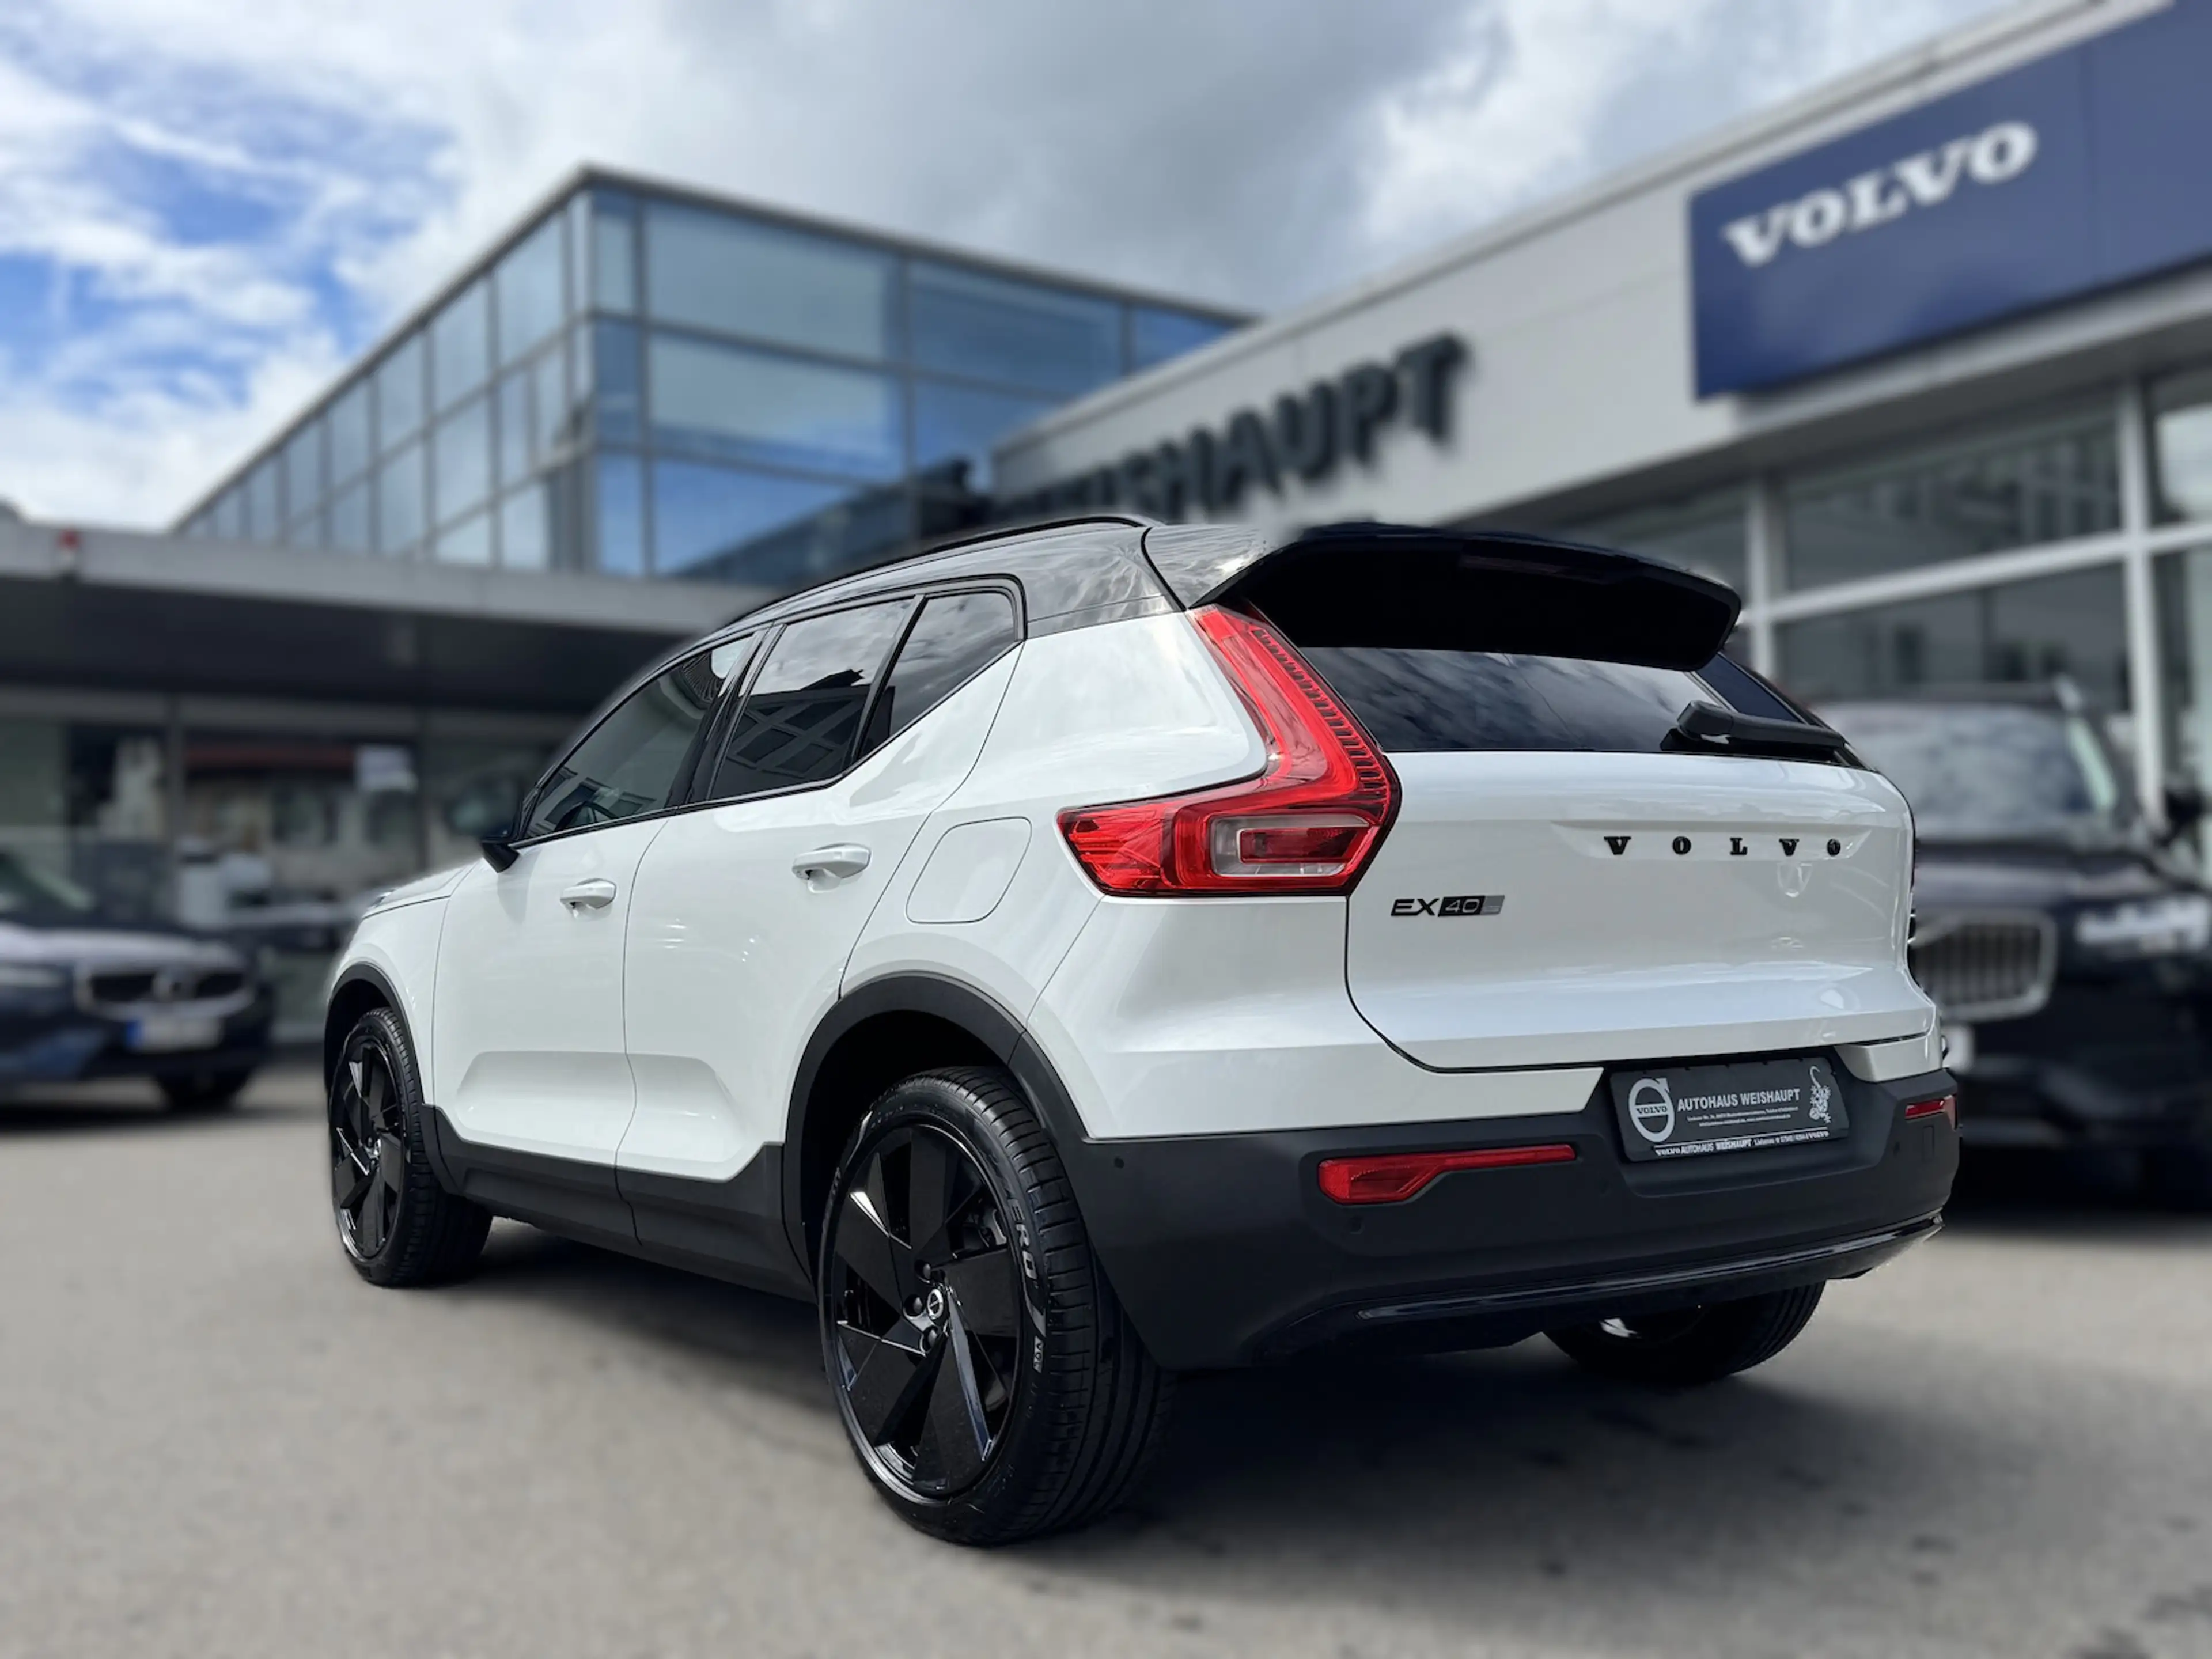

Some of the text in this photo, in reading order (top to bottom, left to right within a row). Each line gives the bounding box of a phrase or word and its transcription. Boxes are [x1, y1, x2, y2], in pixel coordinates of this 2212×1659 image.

[1721, 120, 2038, 266] VOLVO
[1020, 331, 1467, 523] ISHAUPT
[1604, 835, 1842, 857] VOLVO
[1391, 896, 1481, 916] EX40
[1636, 1105, 1668, 1115] VOLVO
[1677, 1088, 1801, 1112] AUTOHAUS WEISHAUPT
